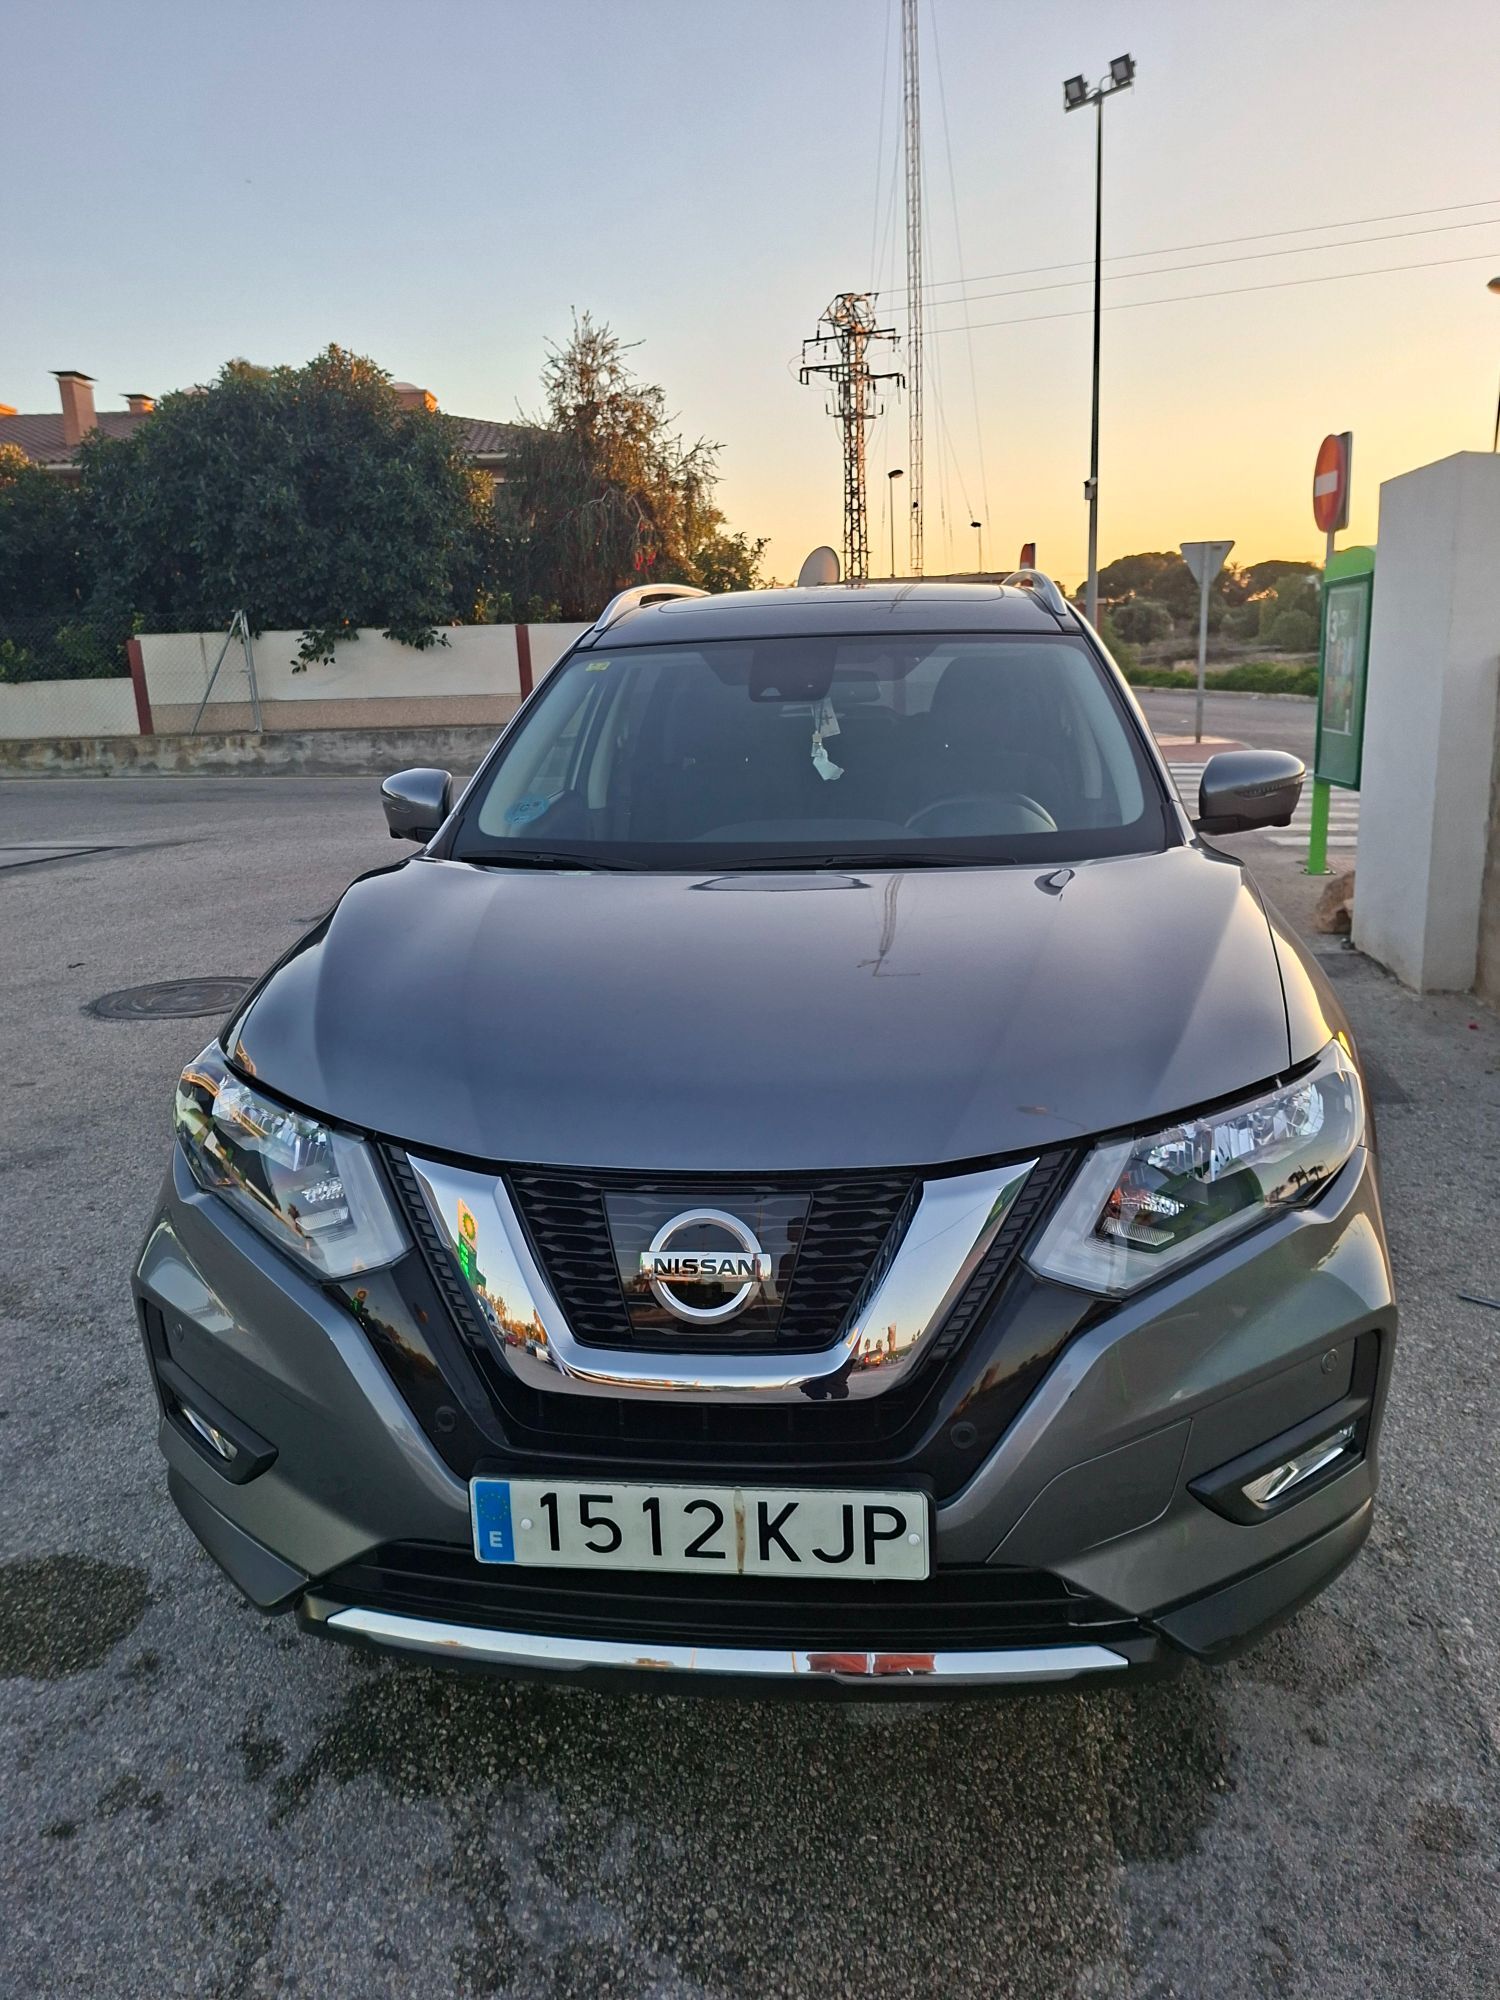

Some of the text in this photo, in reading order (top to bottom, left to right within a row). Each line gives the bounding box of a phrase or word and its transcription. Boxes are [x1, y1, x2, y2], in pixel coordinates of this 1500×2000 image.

[653, 1257, 756, 1276] NISSAN
[539, 1492, 908, 1566] 1512 KJP
[489, 1530, 503, 1548] E
